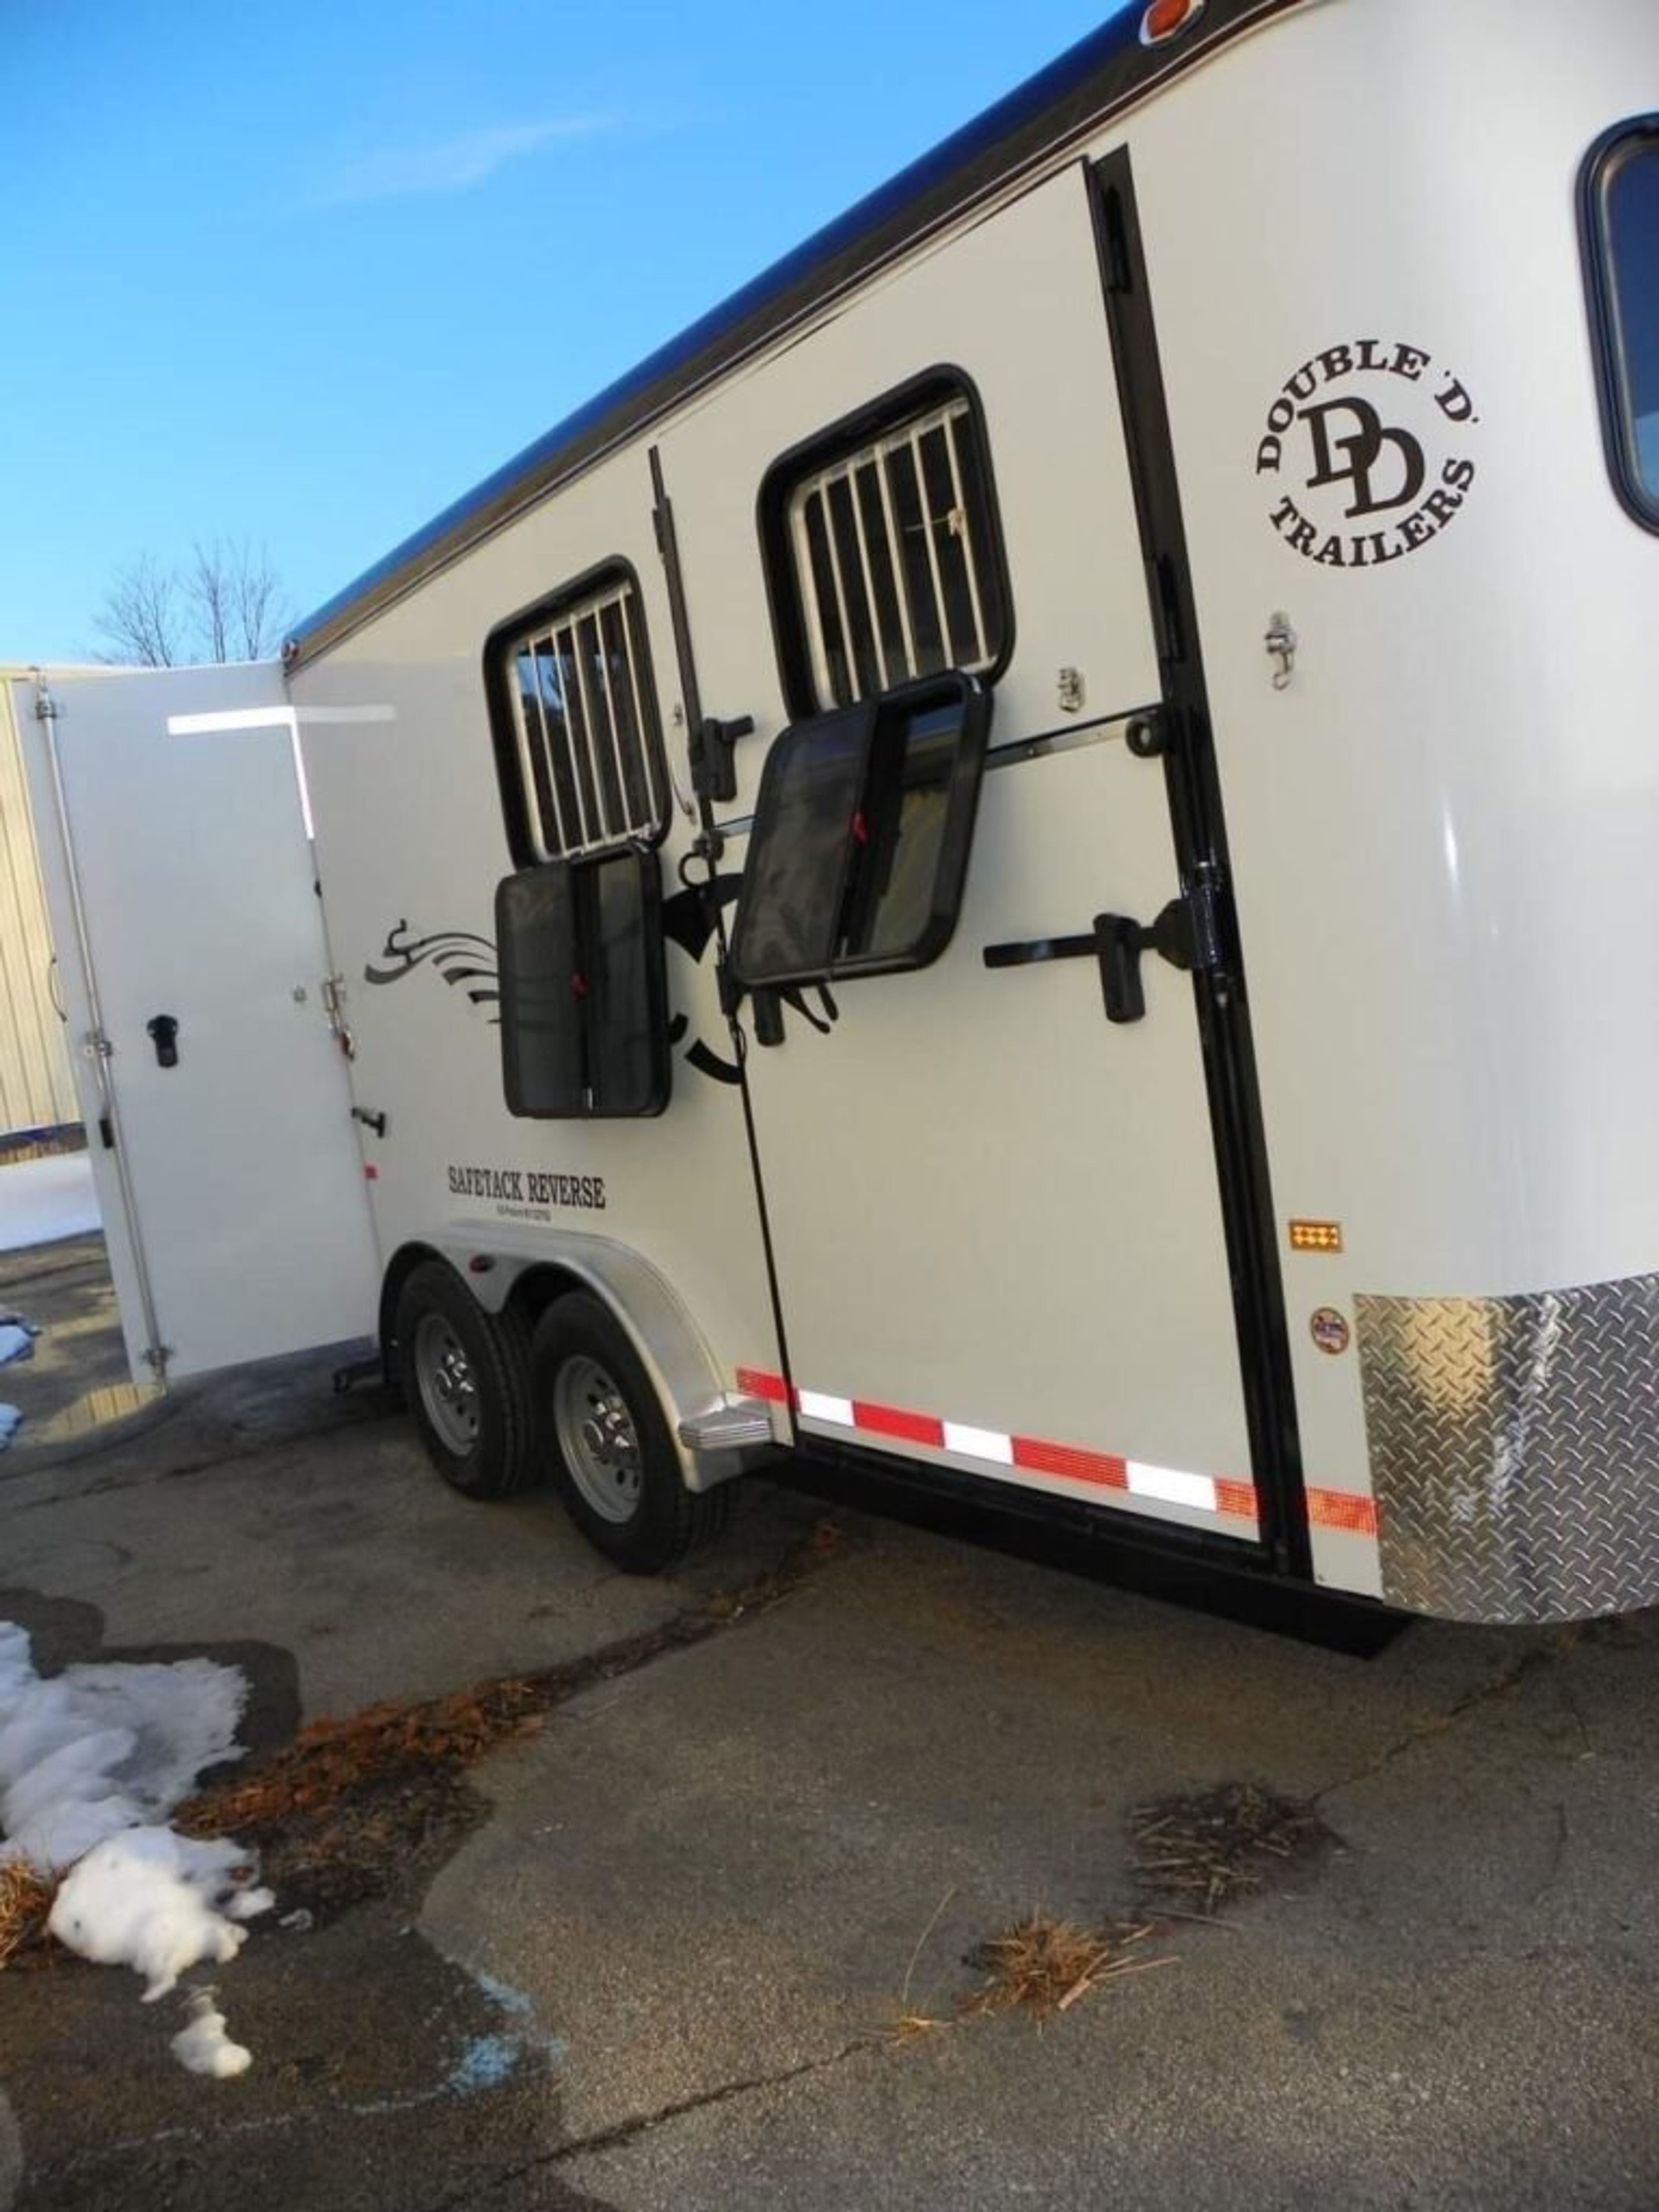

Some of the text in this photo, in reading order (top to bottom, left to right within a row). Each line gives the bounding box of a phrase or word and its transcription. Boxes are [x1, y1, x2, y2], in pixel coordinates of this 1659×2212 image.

[1255, 339, 1431, 475] DOUBLE
[1297, 396, 1425, 519] DD
[1269, 458, 1475, 567] TRAILERS
[448, 1165, 606, 1210] SAFETACK REVERSE
